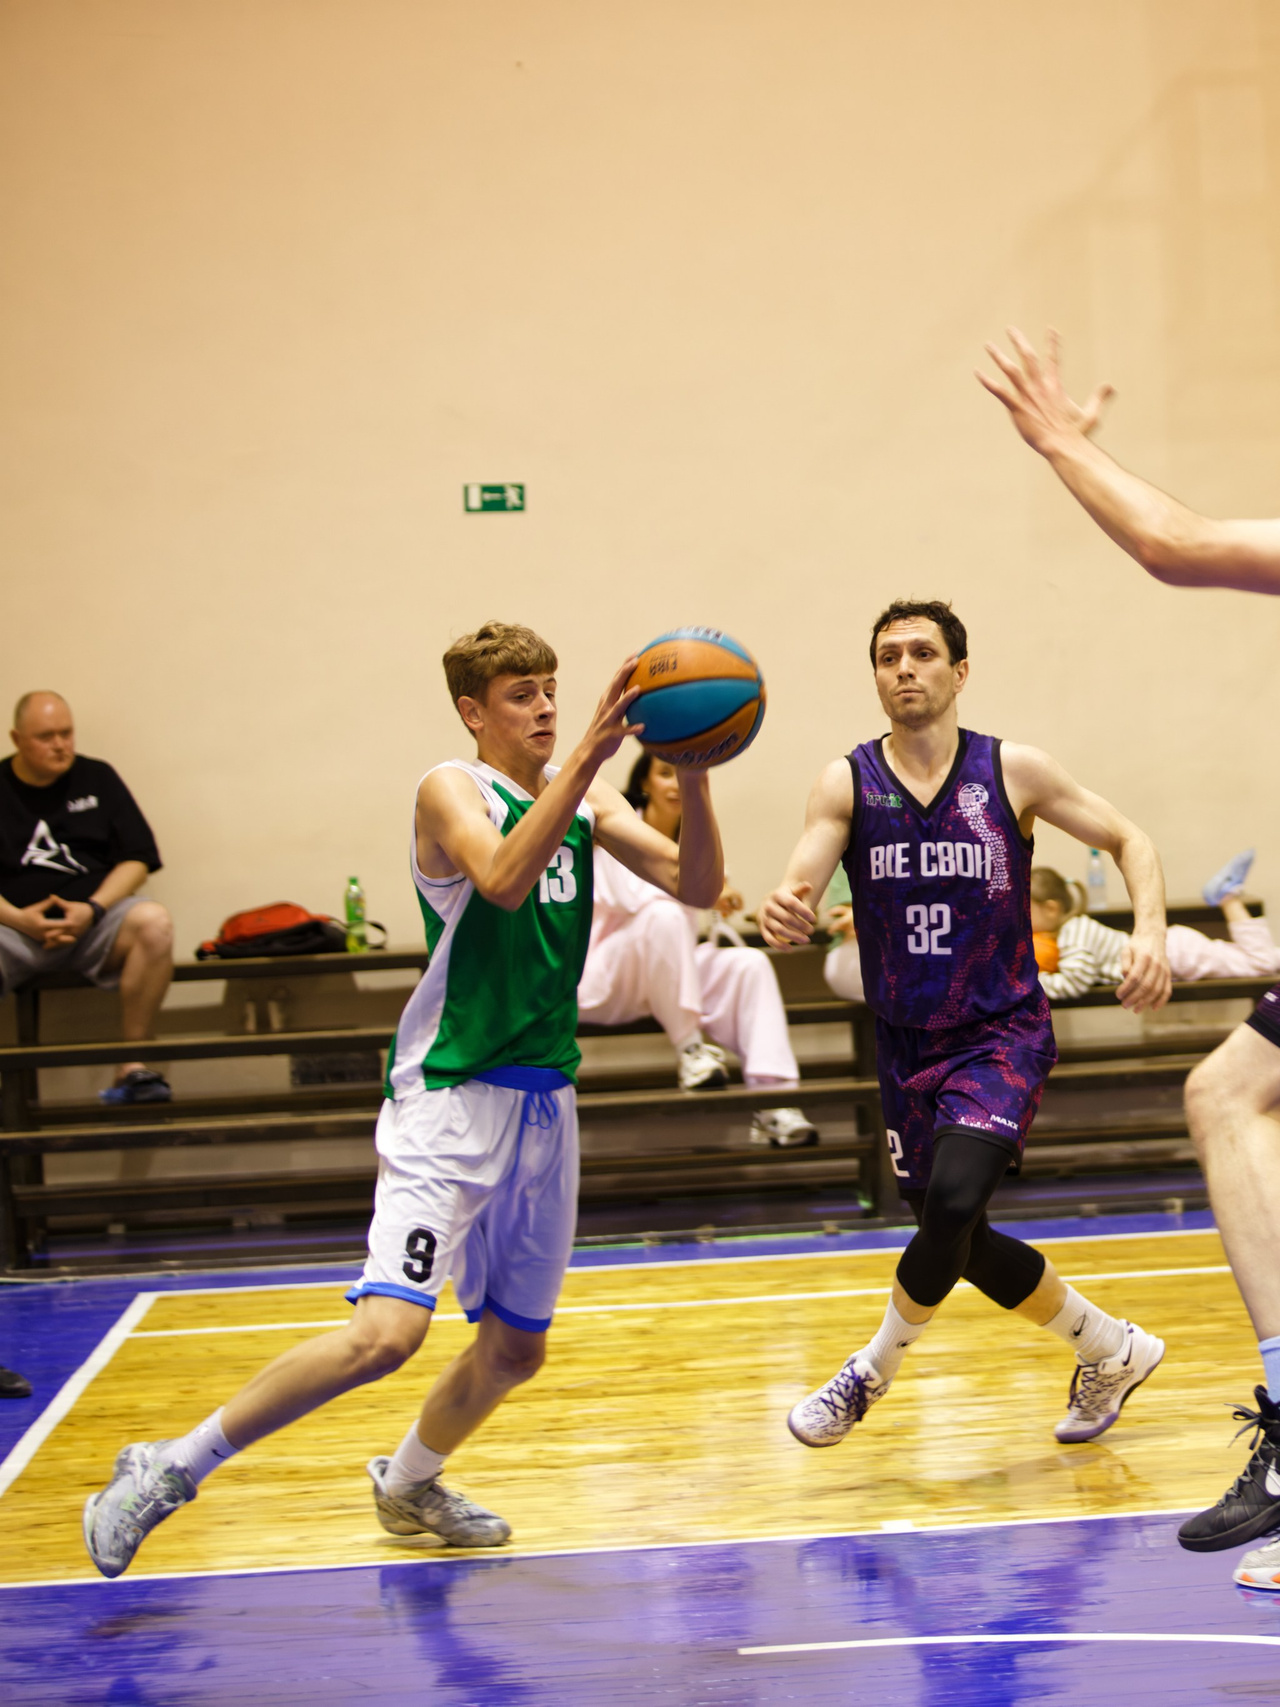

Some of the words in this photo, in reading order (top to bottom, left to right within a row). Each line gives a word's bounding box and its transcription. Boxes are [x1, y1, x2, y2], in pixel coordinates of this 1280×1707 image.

[539, 845, 578, 904] 13
[869, 842, 911, 881] ВСЕ
[905, 902, 953, 956] 32
[990, 1114, 1019, 1131] MAXX
[402, 1227, 438, 1284] 9
